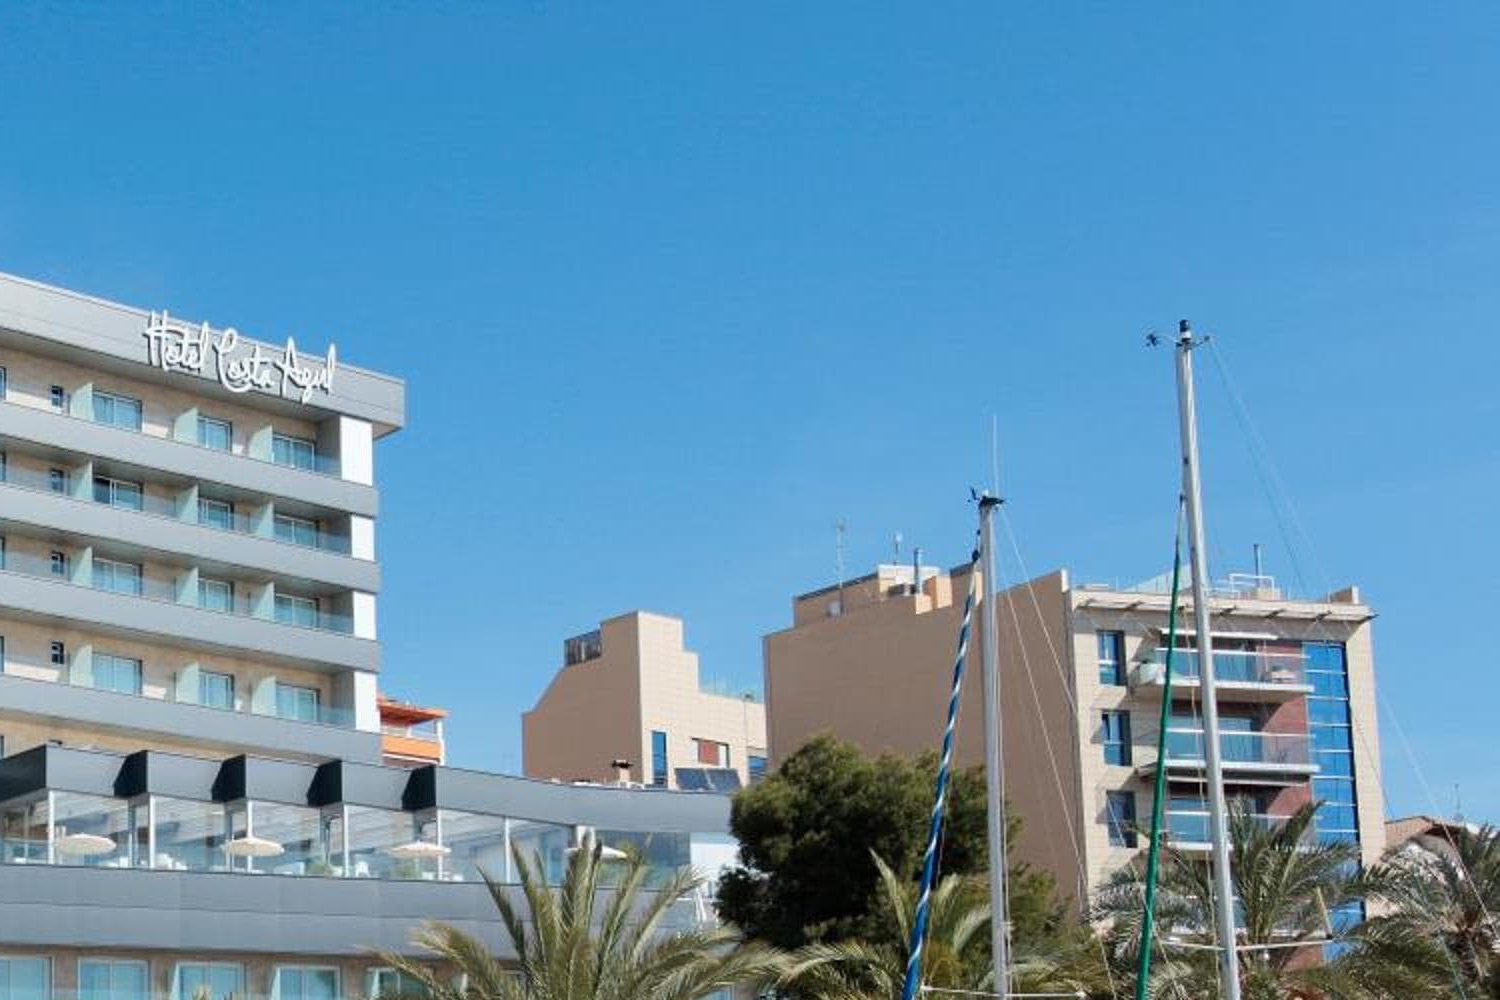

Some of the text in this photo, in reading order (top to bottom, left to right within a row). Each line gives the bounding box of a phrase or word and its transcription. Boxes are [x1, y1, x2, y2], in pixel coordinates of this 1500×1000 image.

[145, 309, 337, 404] Hotel Costa Azul
